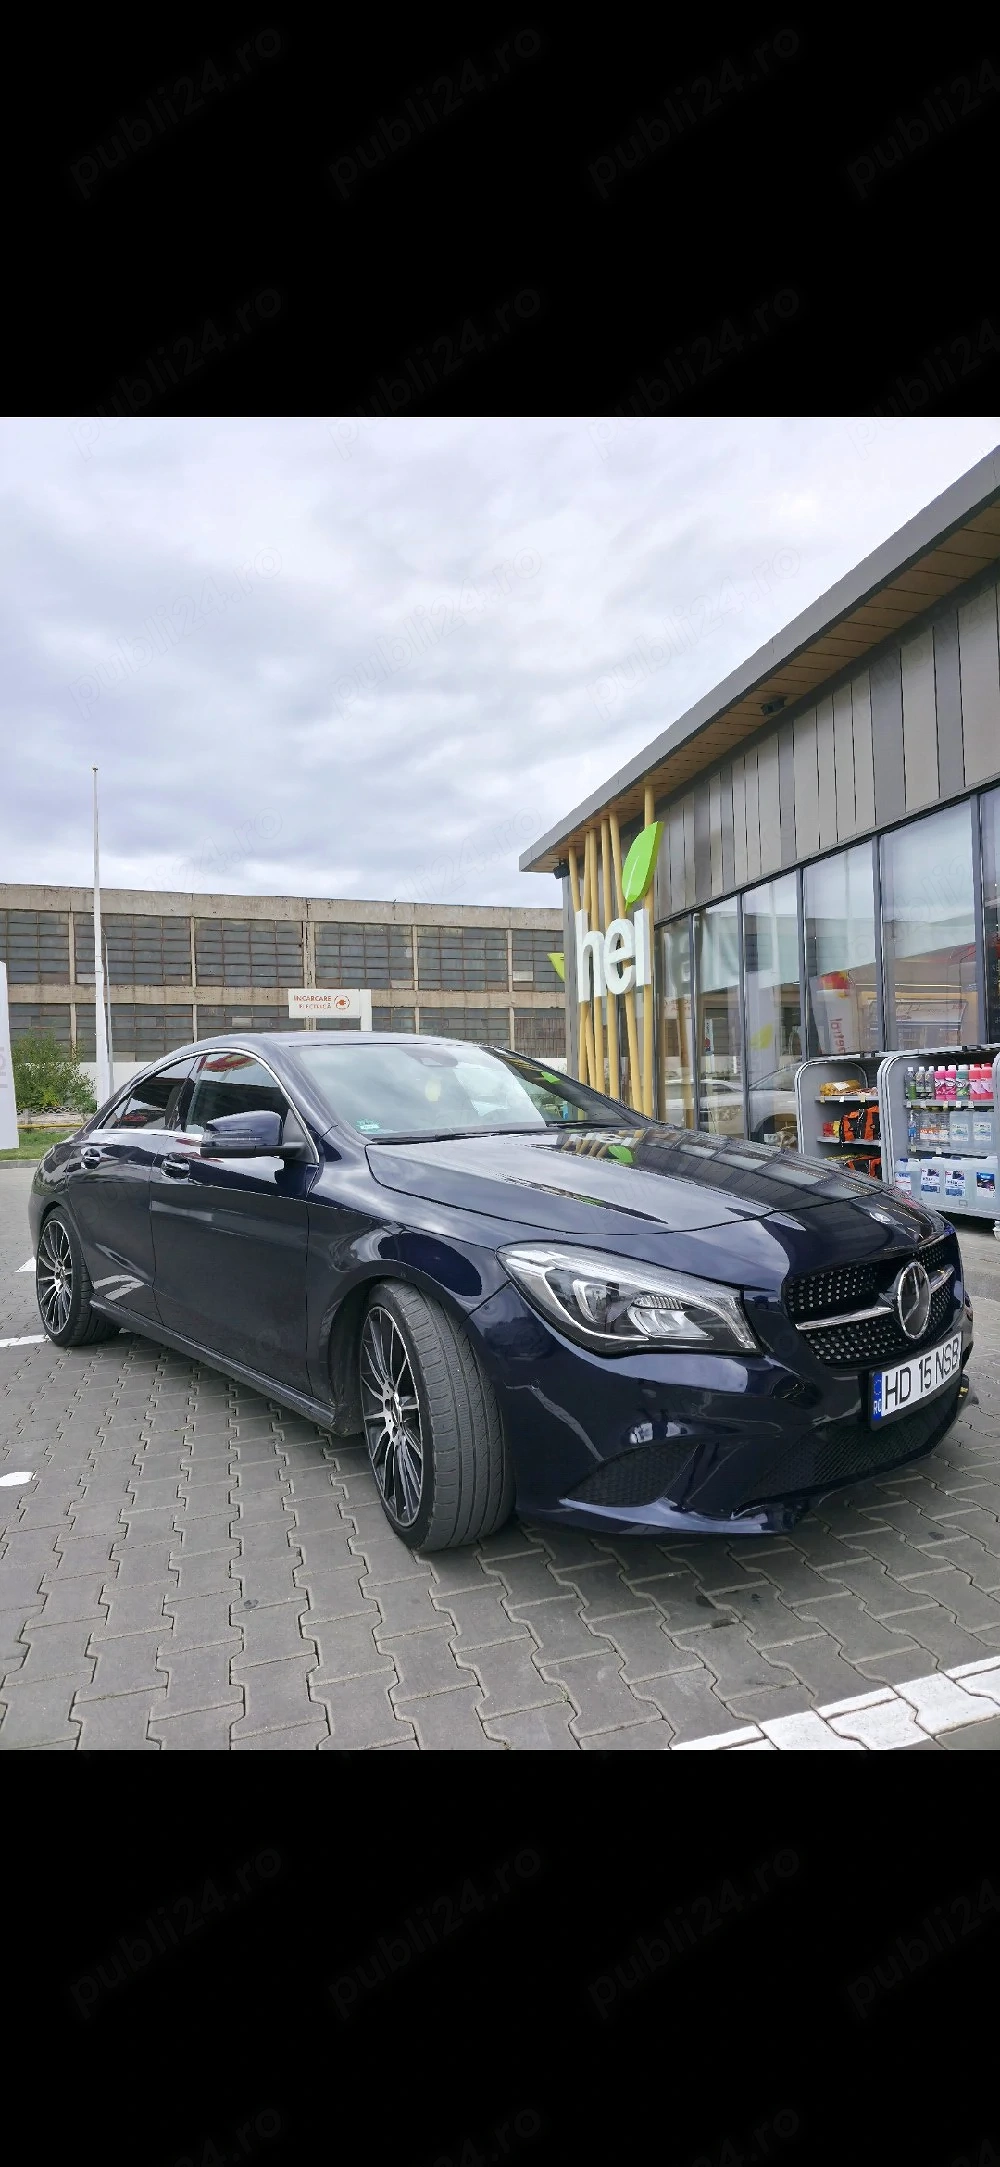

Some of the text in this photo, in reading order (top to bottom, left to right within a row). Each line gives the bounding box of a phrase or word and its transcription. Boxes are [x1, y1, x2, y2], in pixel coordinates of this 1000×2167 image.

[885, 1337, 959, 1410] HD 15 NSB
